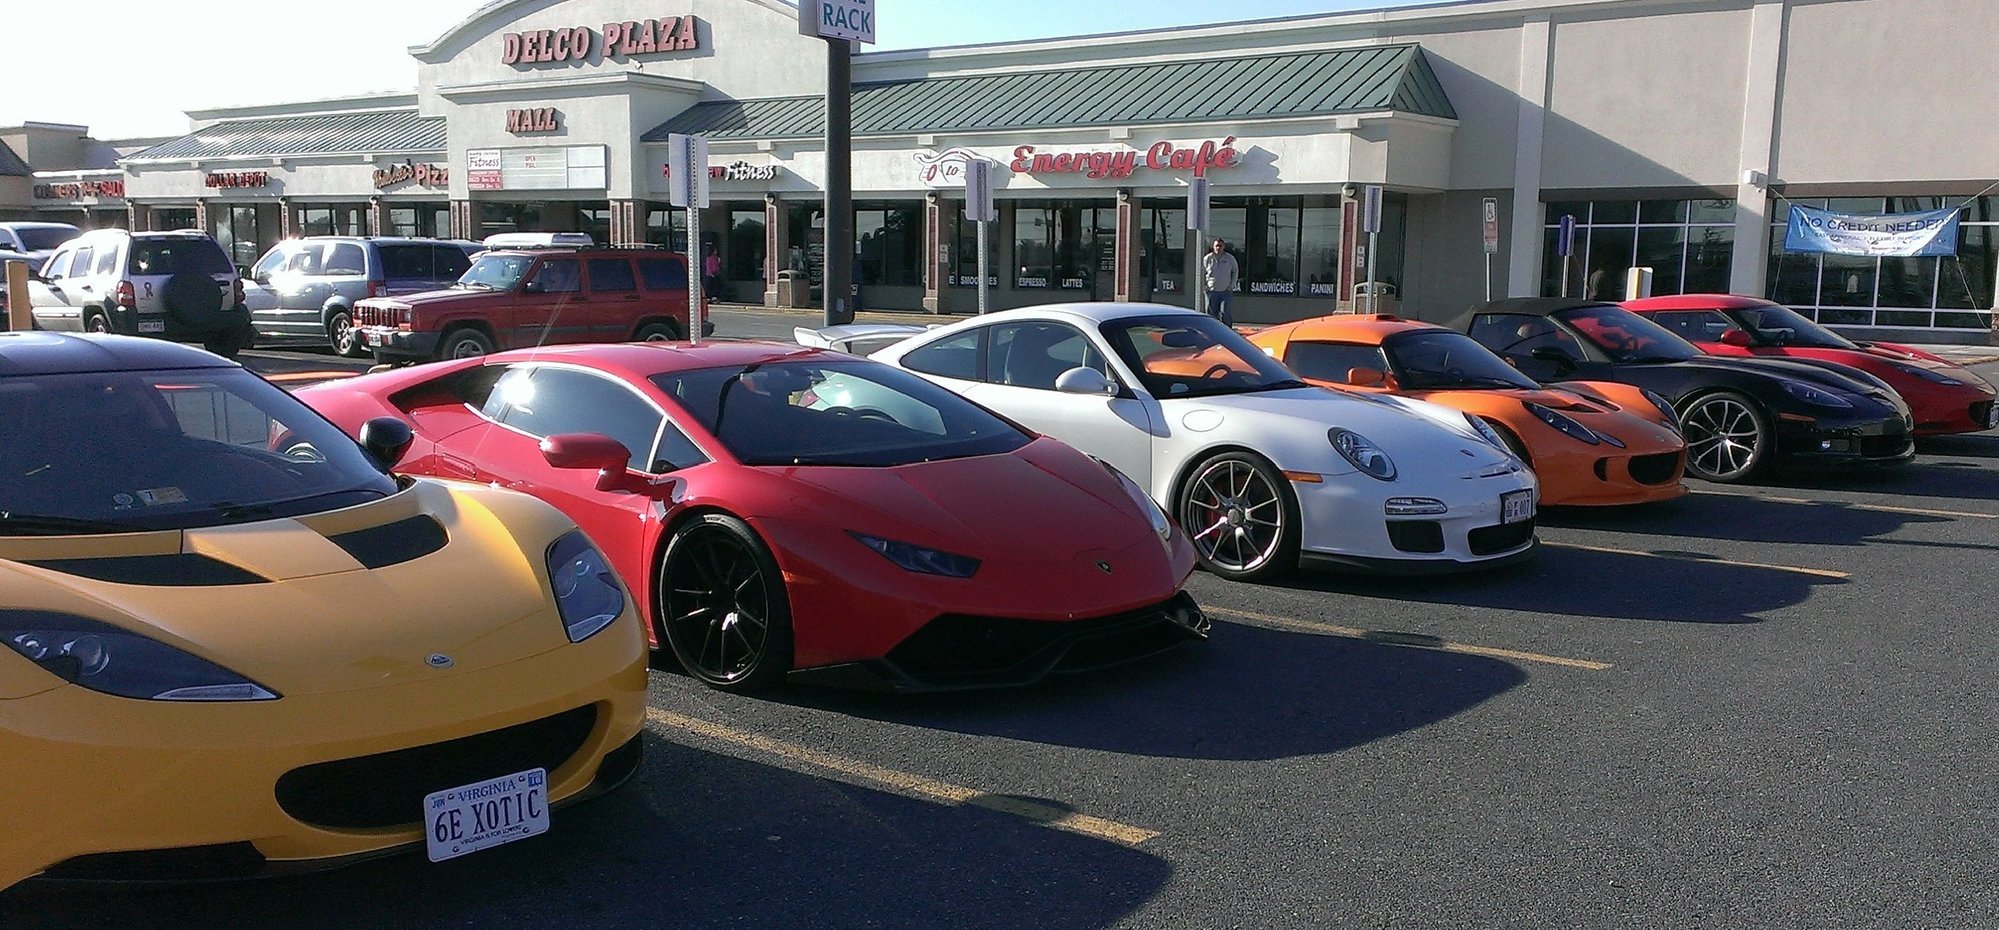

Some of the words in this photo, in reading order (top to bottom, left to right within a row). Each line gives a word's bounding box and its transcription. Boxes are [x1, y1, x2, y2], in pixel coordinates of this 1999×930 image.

[823, 3, 871, 33] RACK
[502, 26, 590, 64] DELCO
[602, 15, 697, 56] PLAZA
[505, 108, 557, 132] MALL
[1010, 146, 1137, 178] Energy
[1146, 136, 1237, 177] Café
[725, 160, 776, 180] Fitness
[1800, 217, 1823, 228] NO
[1827, 219, 1880, 231] CREDIT
[1018, 277, 1046, 288] ESPRESSO
[1061, 278, 1083, 288] LATTES
[1162, 280, 1175, 290] TEA
[1250, 282, 1293, 293] SANDWICHES
[1310, 283, 1333, 293] PANINI
[458, 780, 516, 801] VIRGINIA
[435, 809, 462, 842] 6E
[472, 789, 541, 834] XOTIC
